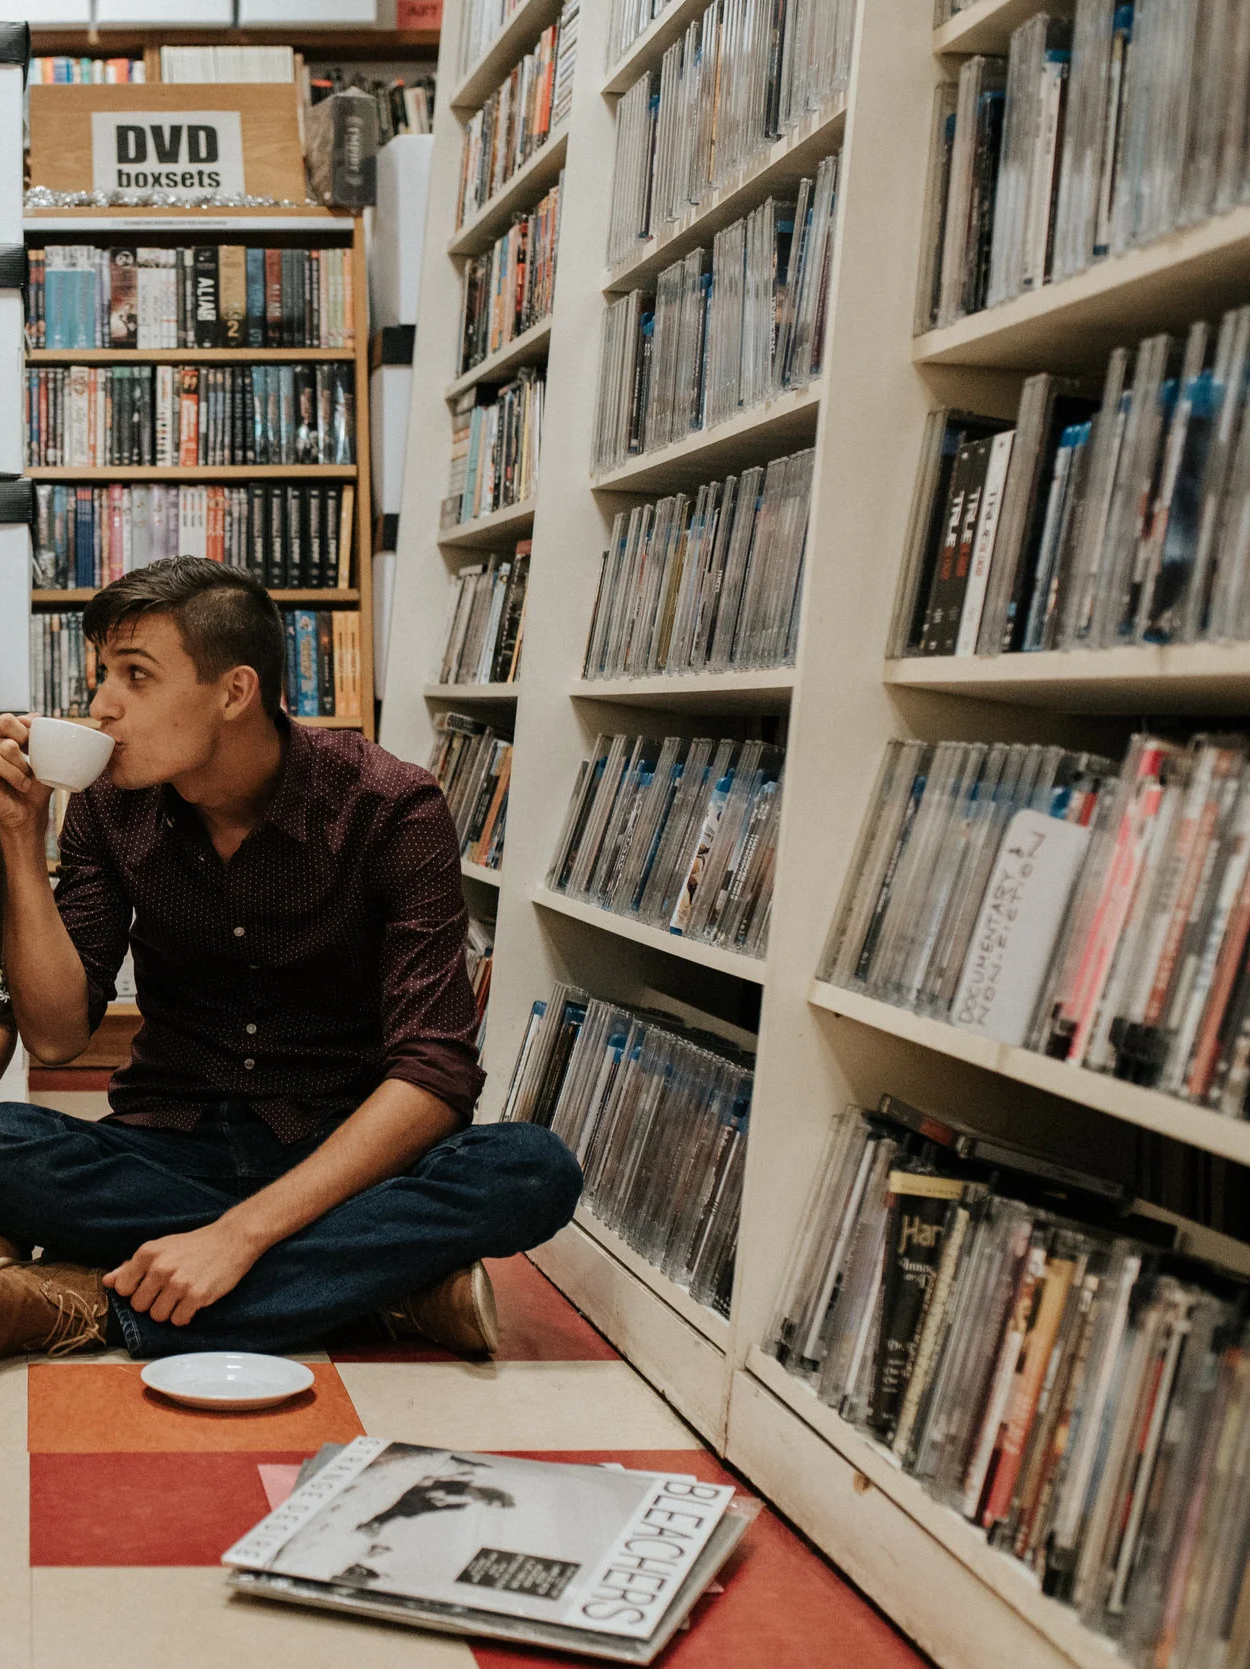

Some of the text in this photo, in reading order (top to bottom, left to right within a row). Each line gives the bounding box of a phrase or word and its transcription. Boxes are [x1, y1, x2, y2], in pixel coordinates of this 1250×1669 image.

[116, 124, 219, 165] DVD
[117, 168, 222, 190] boxsets
[196, 276, 217, 322] ALIAS
[227, 320, 239, 337] 2
[958, 866, 1017, 1026] DOCUMENTARY
[581, 1479, 719, 1626] BLEACHERS
